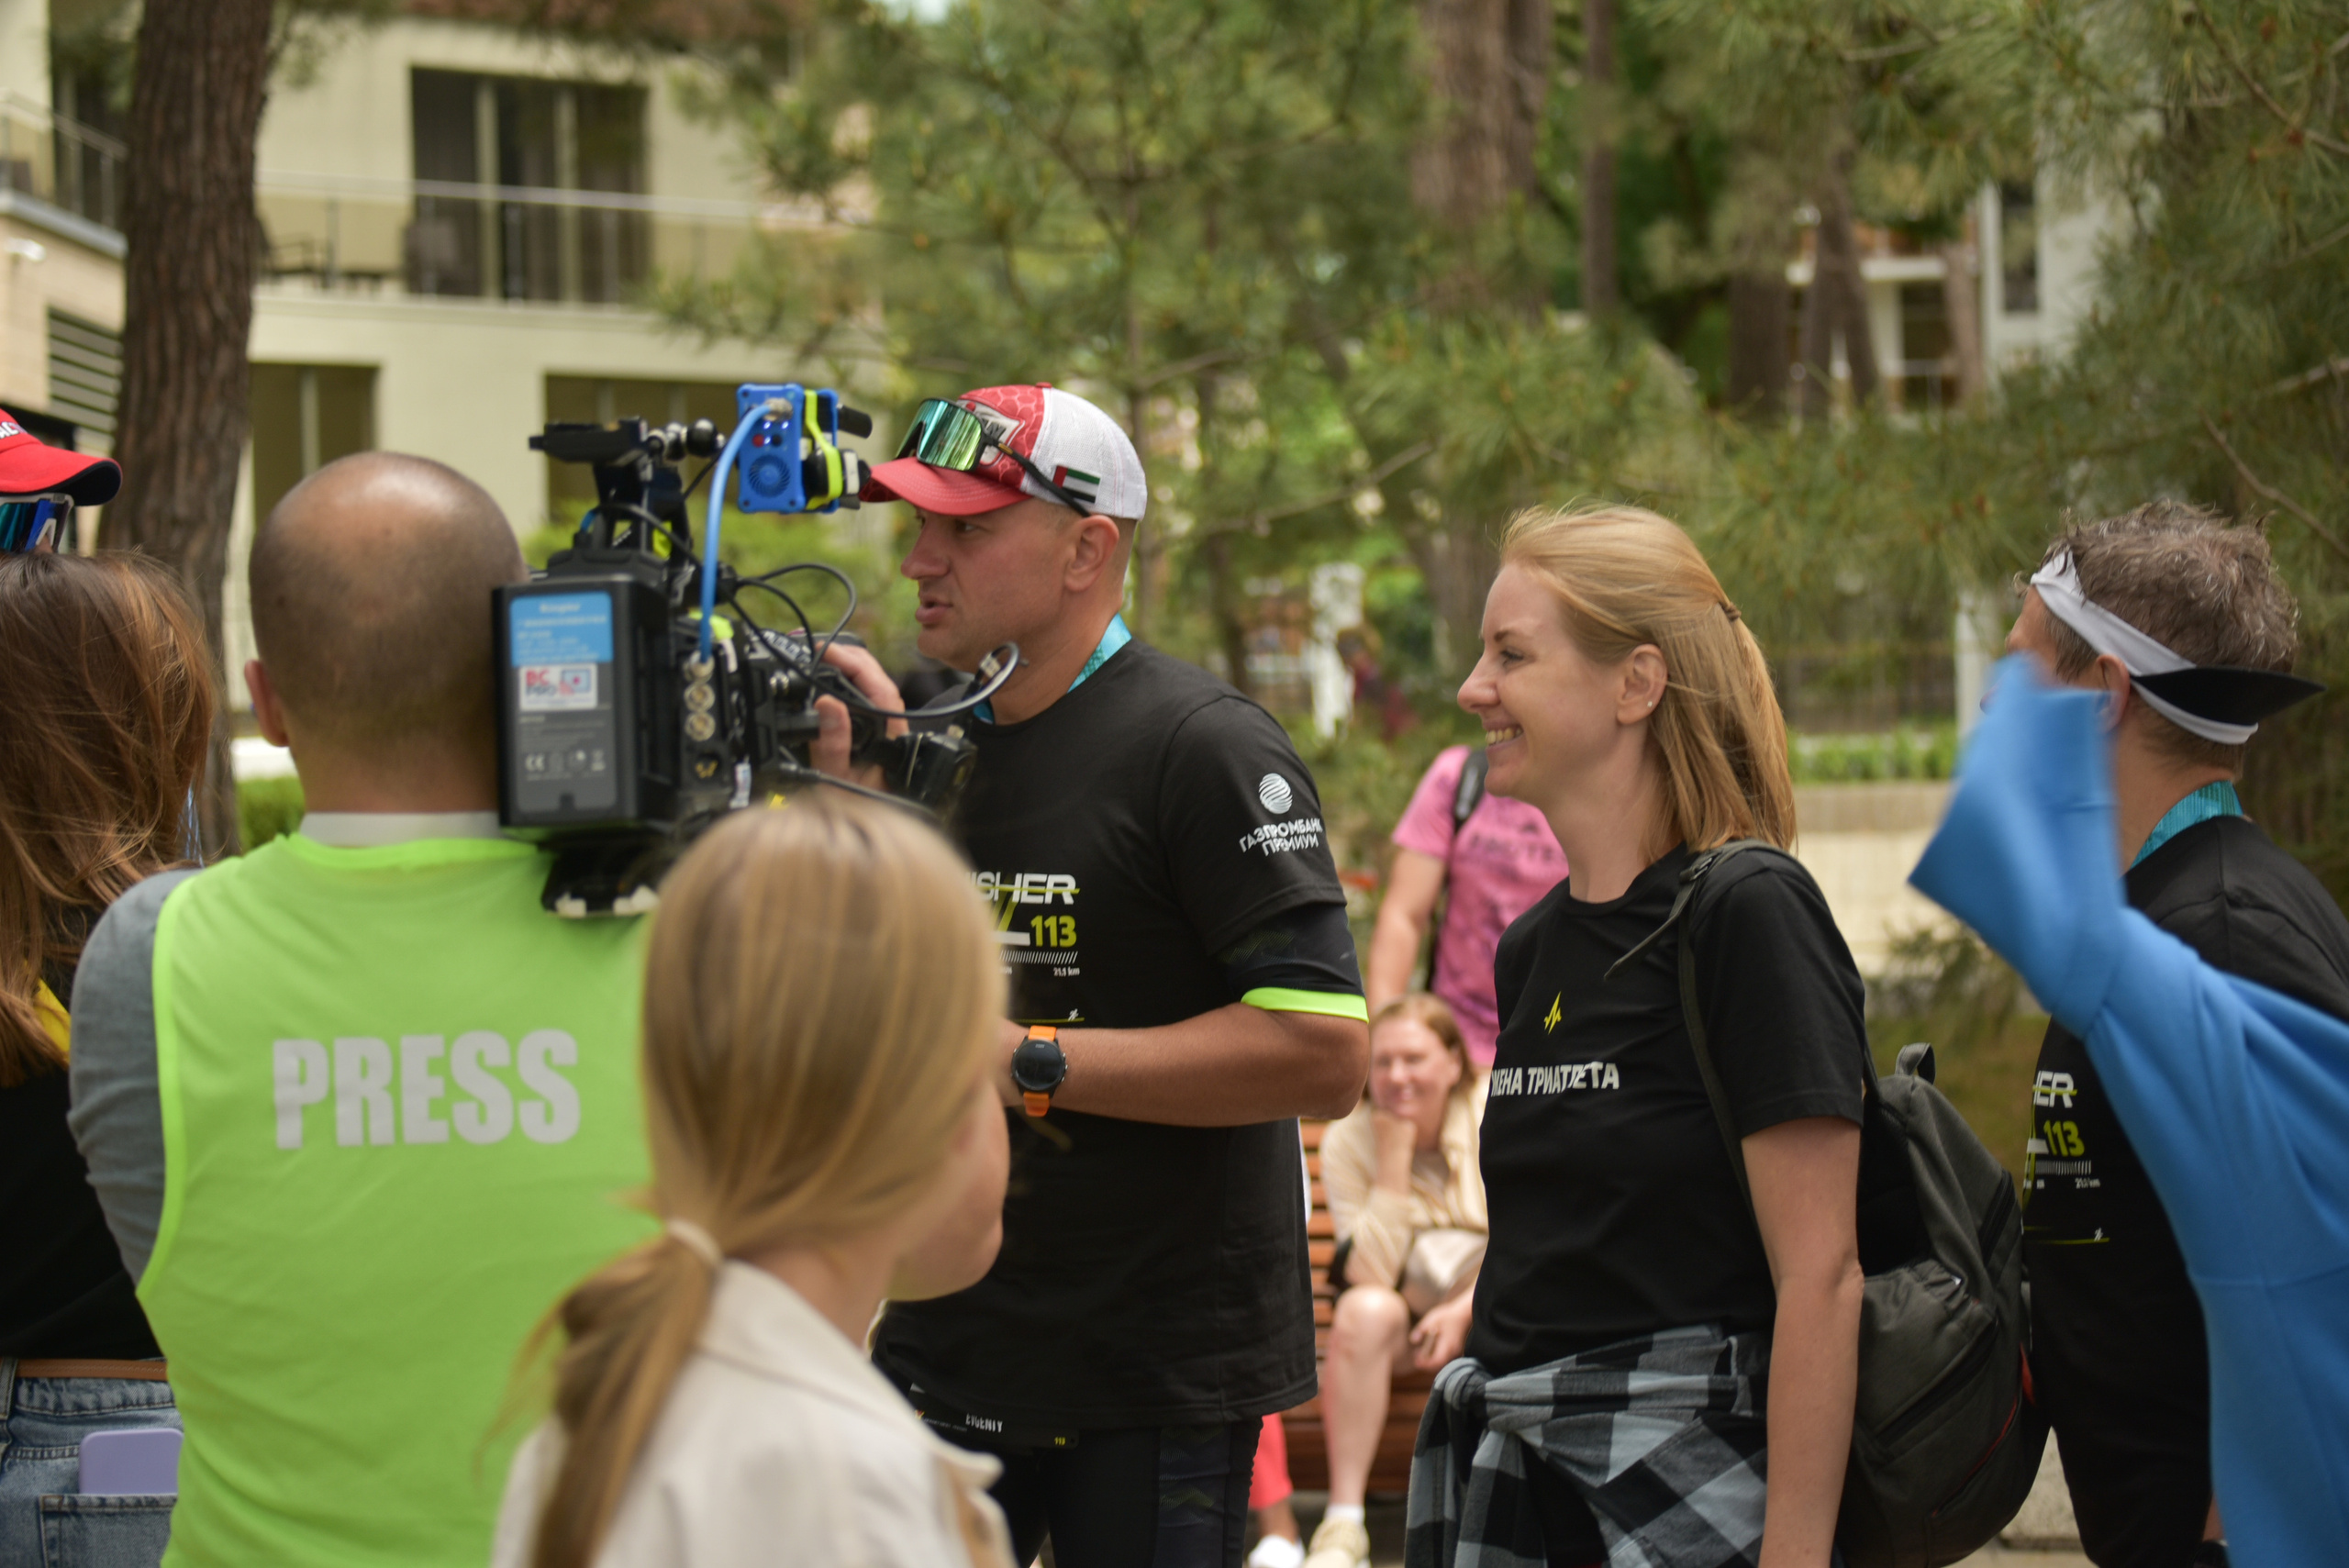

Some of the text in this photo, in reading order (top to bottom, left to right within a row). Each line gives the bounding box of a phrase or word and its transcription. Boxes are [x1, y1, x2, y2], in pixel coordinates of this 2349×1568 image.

[1239, 817, 1323, 853] ГАЗПРОМБАНК
[1030, 915, 1077, 947] 113
[273, 1028, 581, 1149] PRESS
[1490, 1067, 1522, 1097] ЖЕНА
[2033, 1070, 2074, 1108] ER
[2043, 1120, 2085, 1157] 113
[965, 1413, 1003, 1433] EVGENIY
